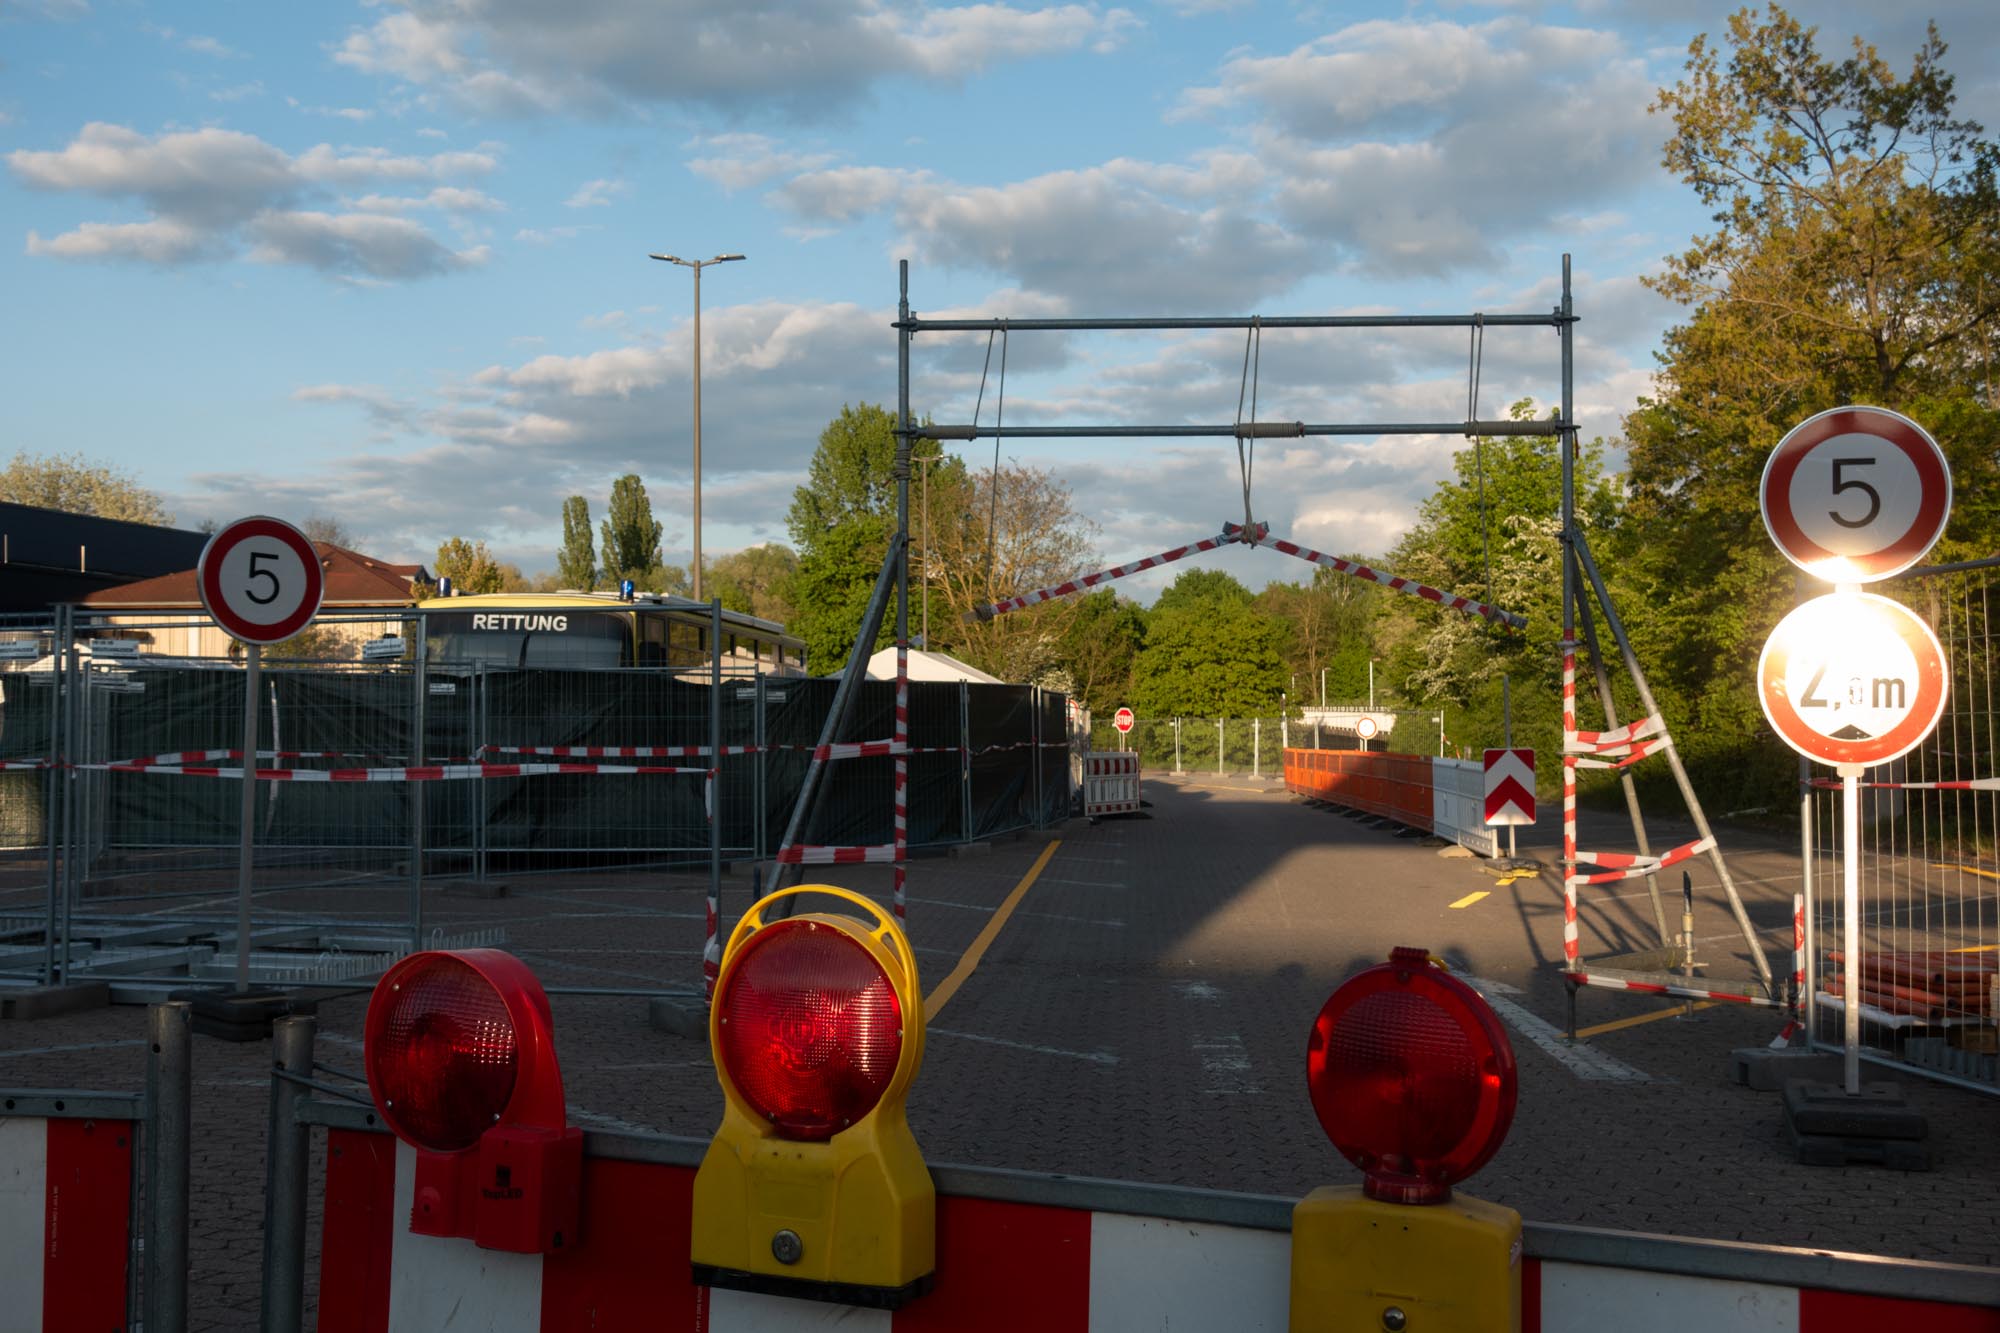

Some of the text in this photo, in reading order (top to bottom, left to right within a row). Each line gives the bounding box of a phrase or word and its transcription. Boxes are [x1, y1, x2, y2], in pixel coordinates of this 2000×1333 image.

[1828, 457, 1881, 529] 5
[245, 551, 280, 605] 5
[472, 613, 568, 632] RETTUNG
[1116, 714, 1132, 726] STOP
